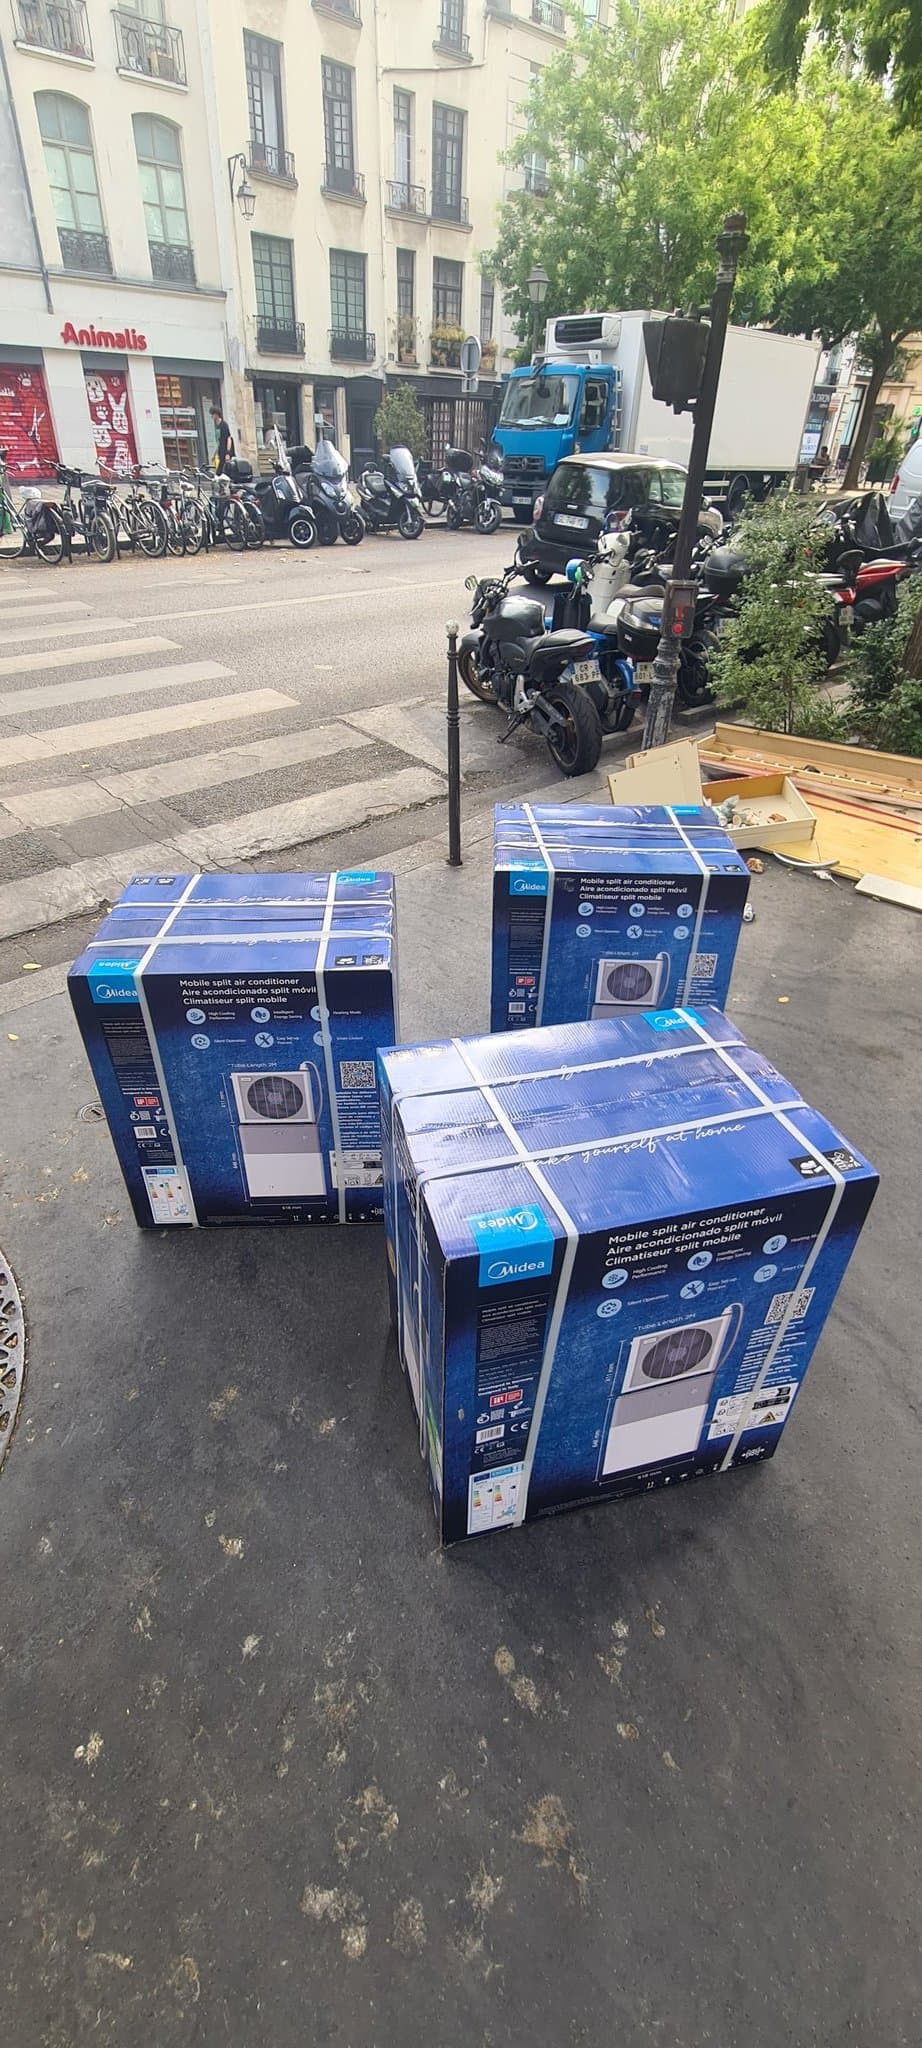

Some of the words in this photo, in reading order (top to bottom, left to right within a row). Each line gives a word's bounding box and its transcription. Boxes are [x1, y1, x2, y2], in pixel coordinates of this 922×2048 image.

[60, 322, 147, 350] Animalis
[99, 985, 138, 998] Midea
[180, 979, 210, 987] Mobile
[212, 978, 232, 988] split
[202, 988, 268, 996] acondicionado
[270, 986, 290, 995] split
[292, 986, 316, 994] móvil
[184, 996, 233, 1005] Climatiseur
[236, 996, 254, 1005] split
[666, 1131, 690, 1143] at
[694, 1124, 745, 1140] home
[478, 1212, 534, 1230] Midea
[608, 1231, 649, 1245] Mobile
[652, 1224, 678, 1239] split
[681, 1220, 696, 1232] air
[699, 1208, 766, 1228] conditioner
[607, 1244, 632, 1256] Aire
[635, 1228, 721, 1250] acondicionado
[724, 1220, 748, 1236] split
[751, 1214, 783, 1228] móvil
[605, 1248, 671, 1267] Climatiseur
[674, 1241, 700, 1256] split
[702, 1232, 742, 1247] mobile
[492, 1262, 545, 1277] Midea
